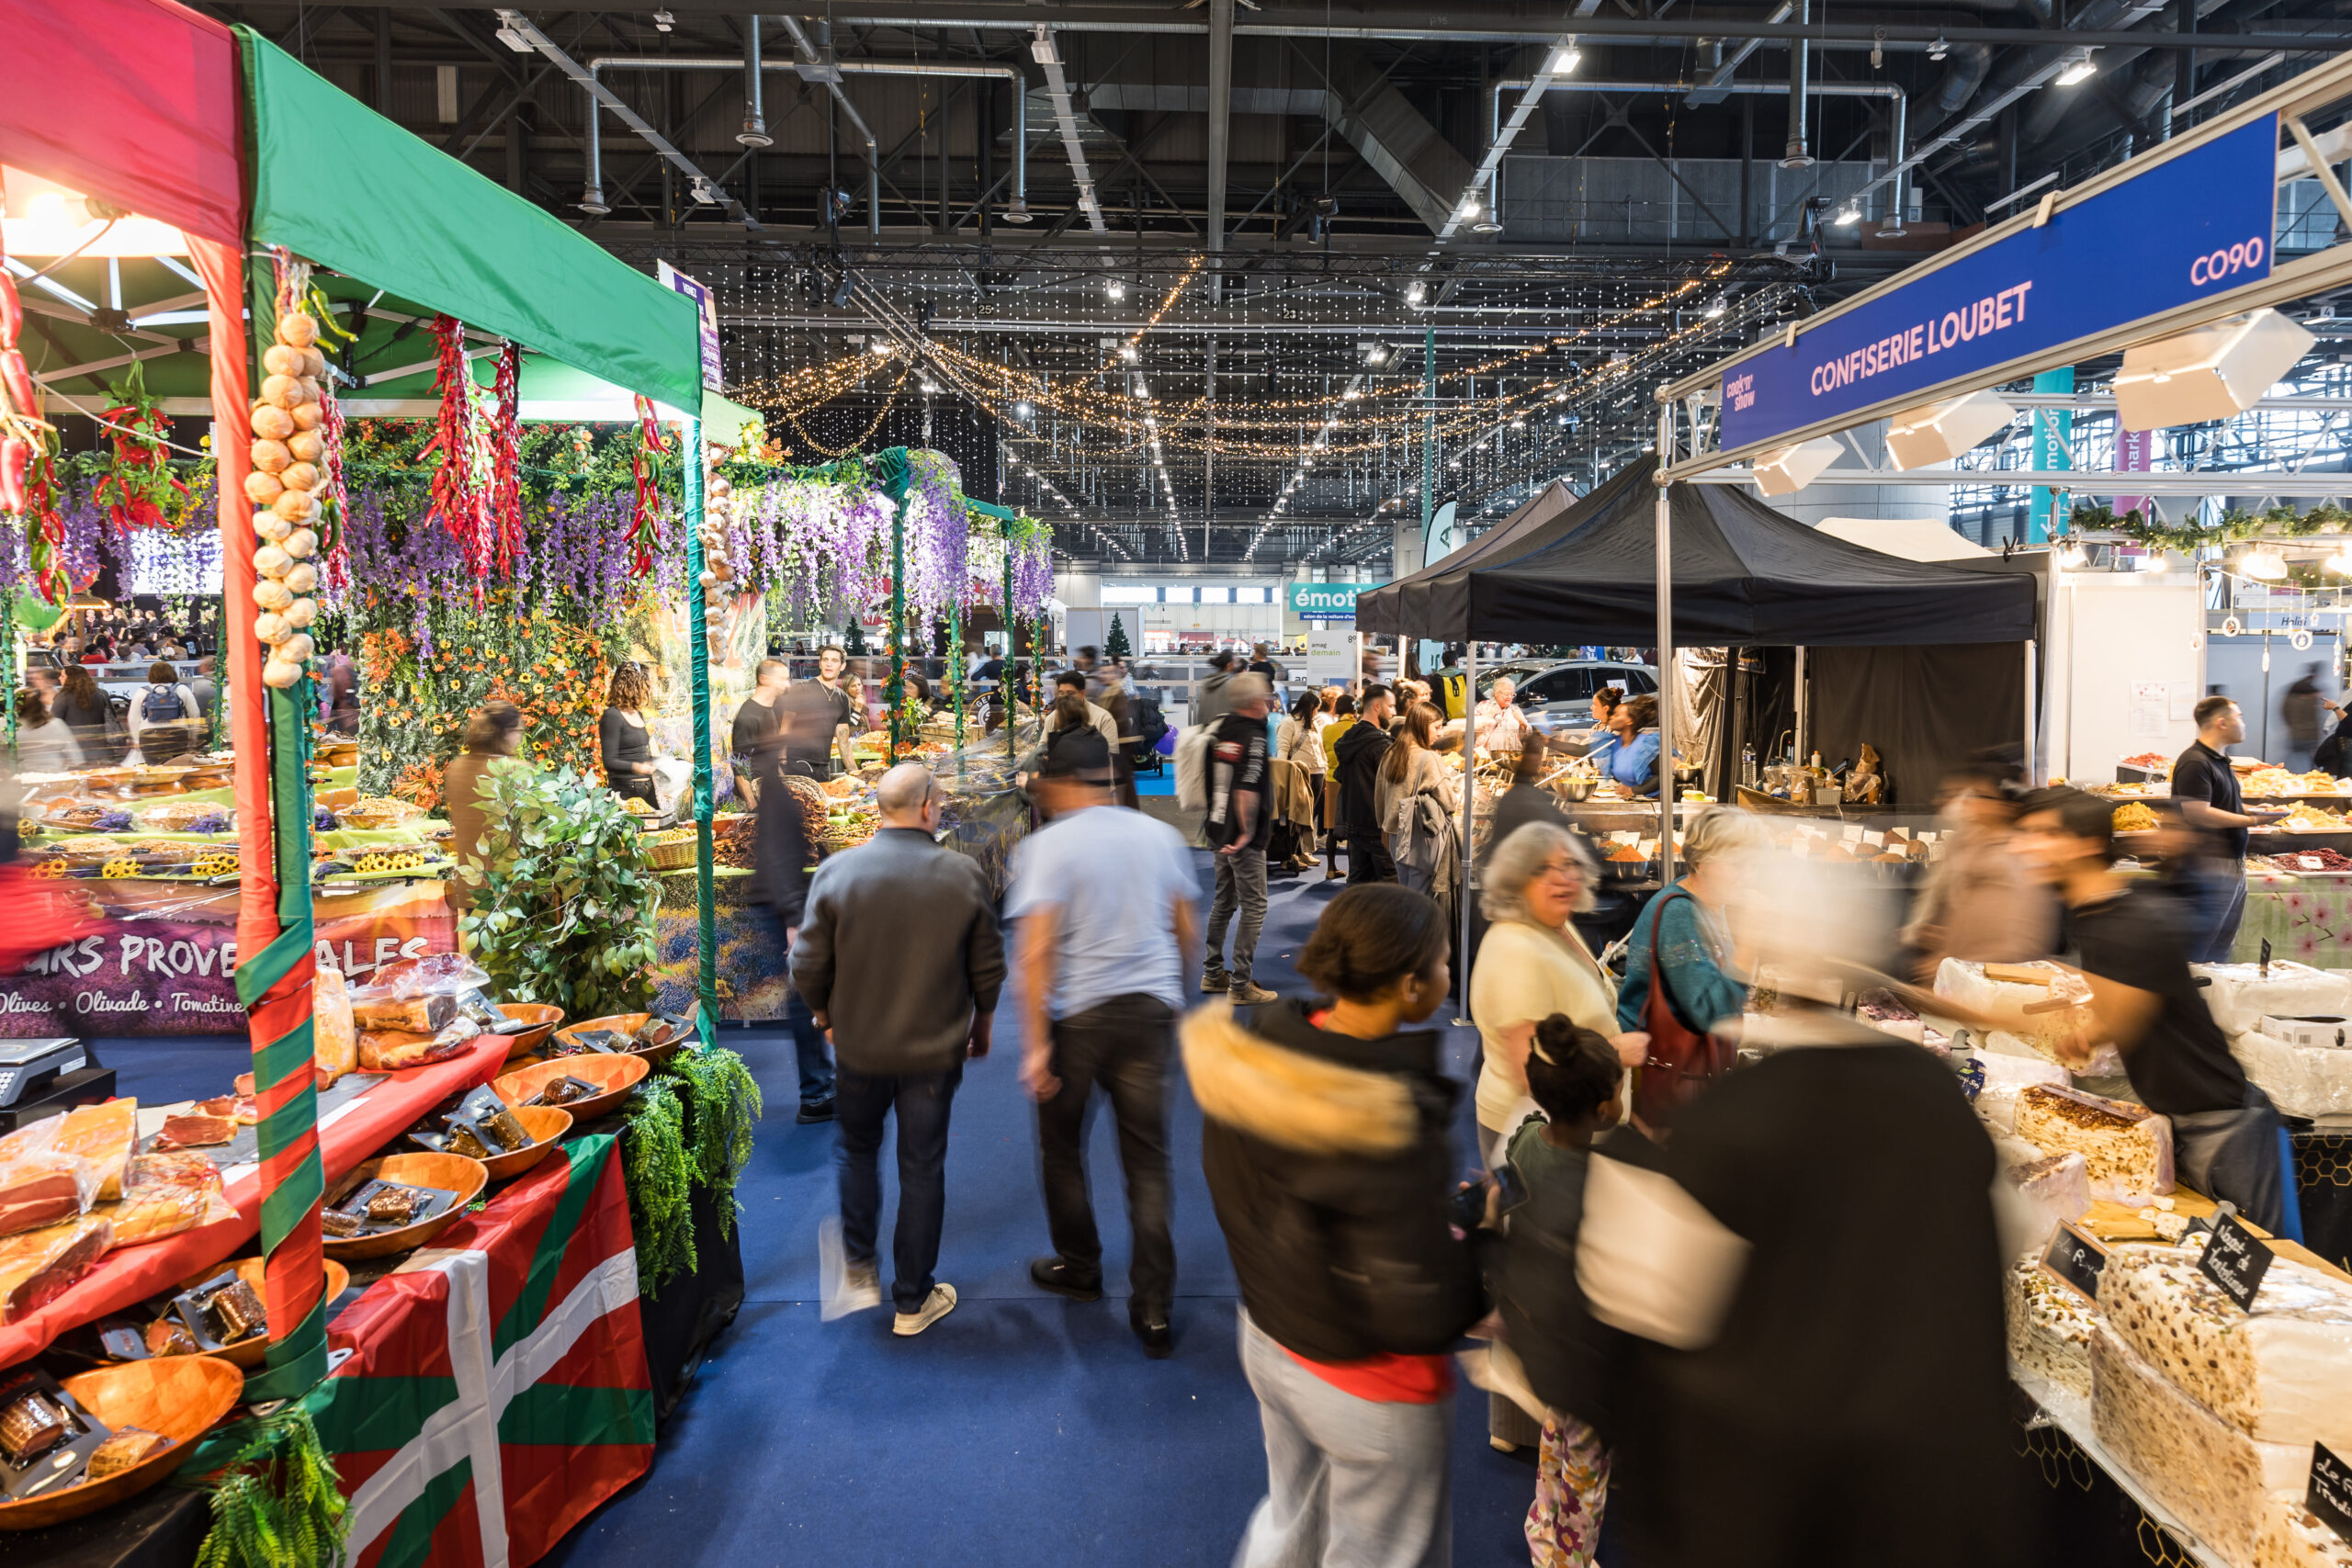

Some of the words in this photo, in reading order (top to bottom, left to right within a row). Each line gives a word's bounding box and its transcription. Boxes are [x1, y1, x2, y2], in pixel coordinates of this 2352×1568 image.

[1415, 283, 1421, 292] 7
[978, 305, 992, 315] 25
[1283, 310, 1296, 320] 23
[2324, 308, 2331, 317] 4
[1583, 314, 1595, 323] 21
[1811, 323, 1924, 396] CONFISERIE
[1928, 280, 2032, 355] LOUBET
[1295, 588, 1362, 607] émot
[75, 989, 150, 1014] Olivade
